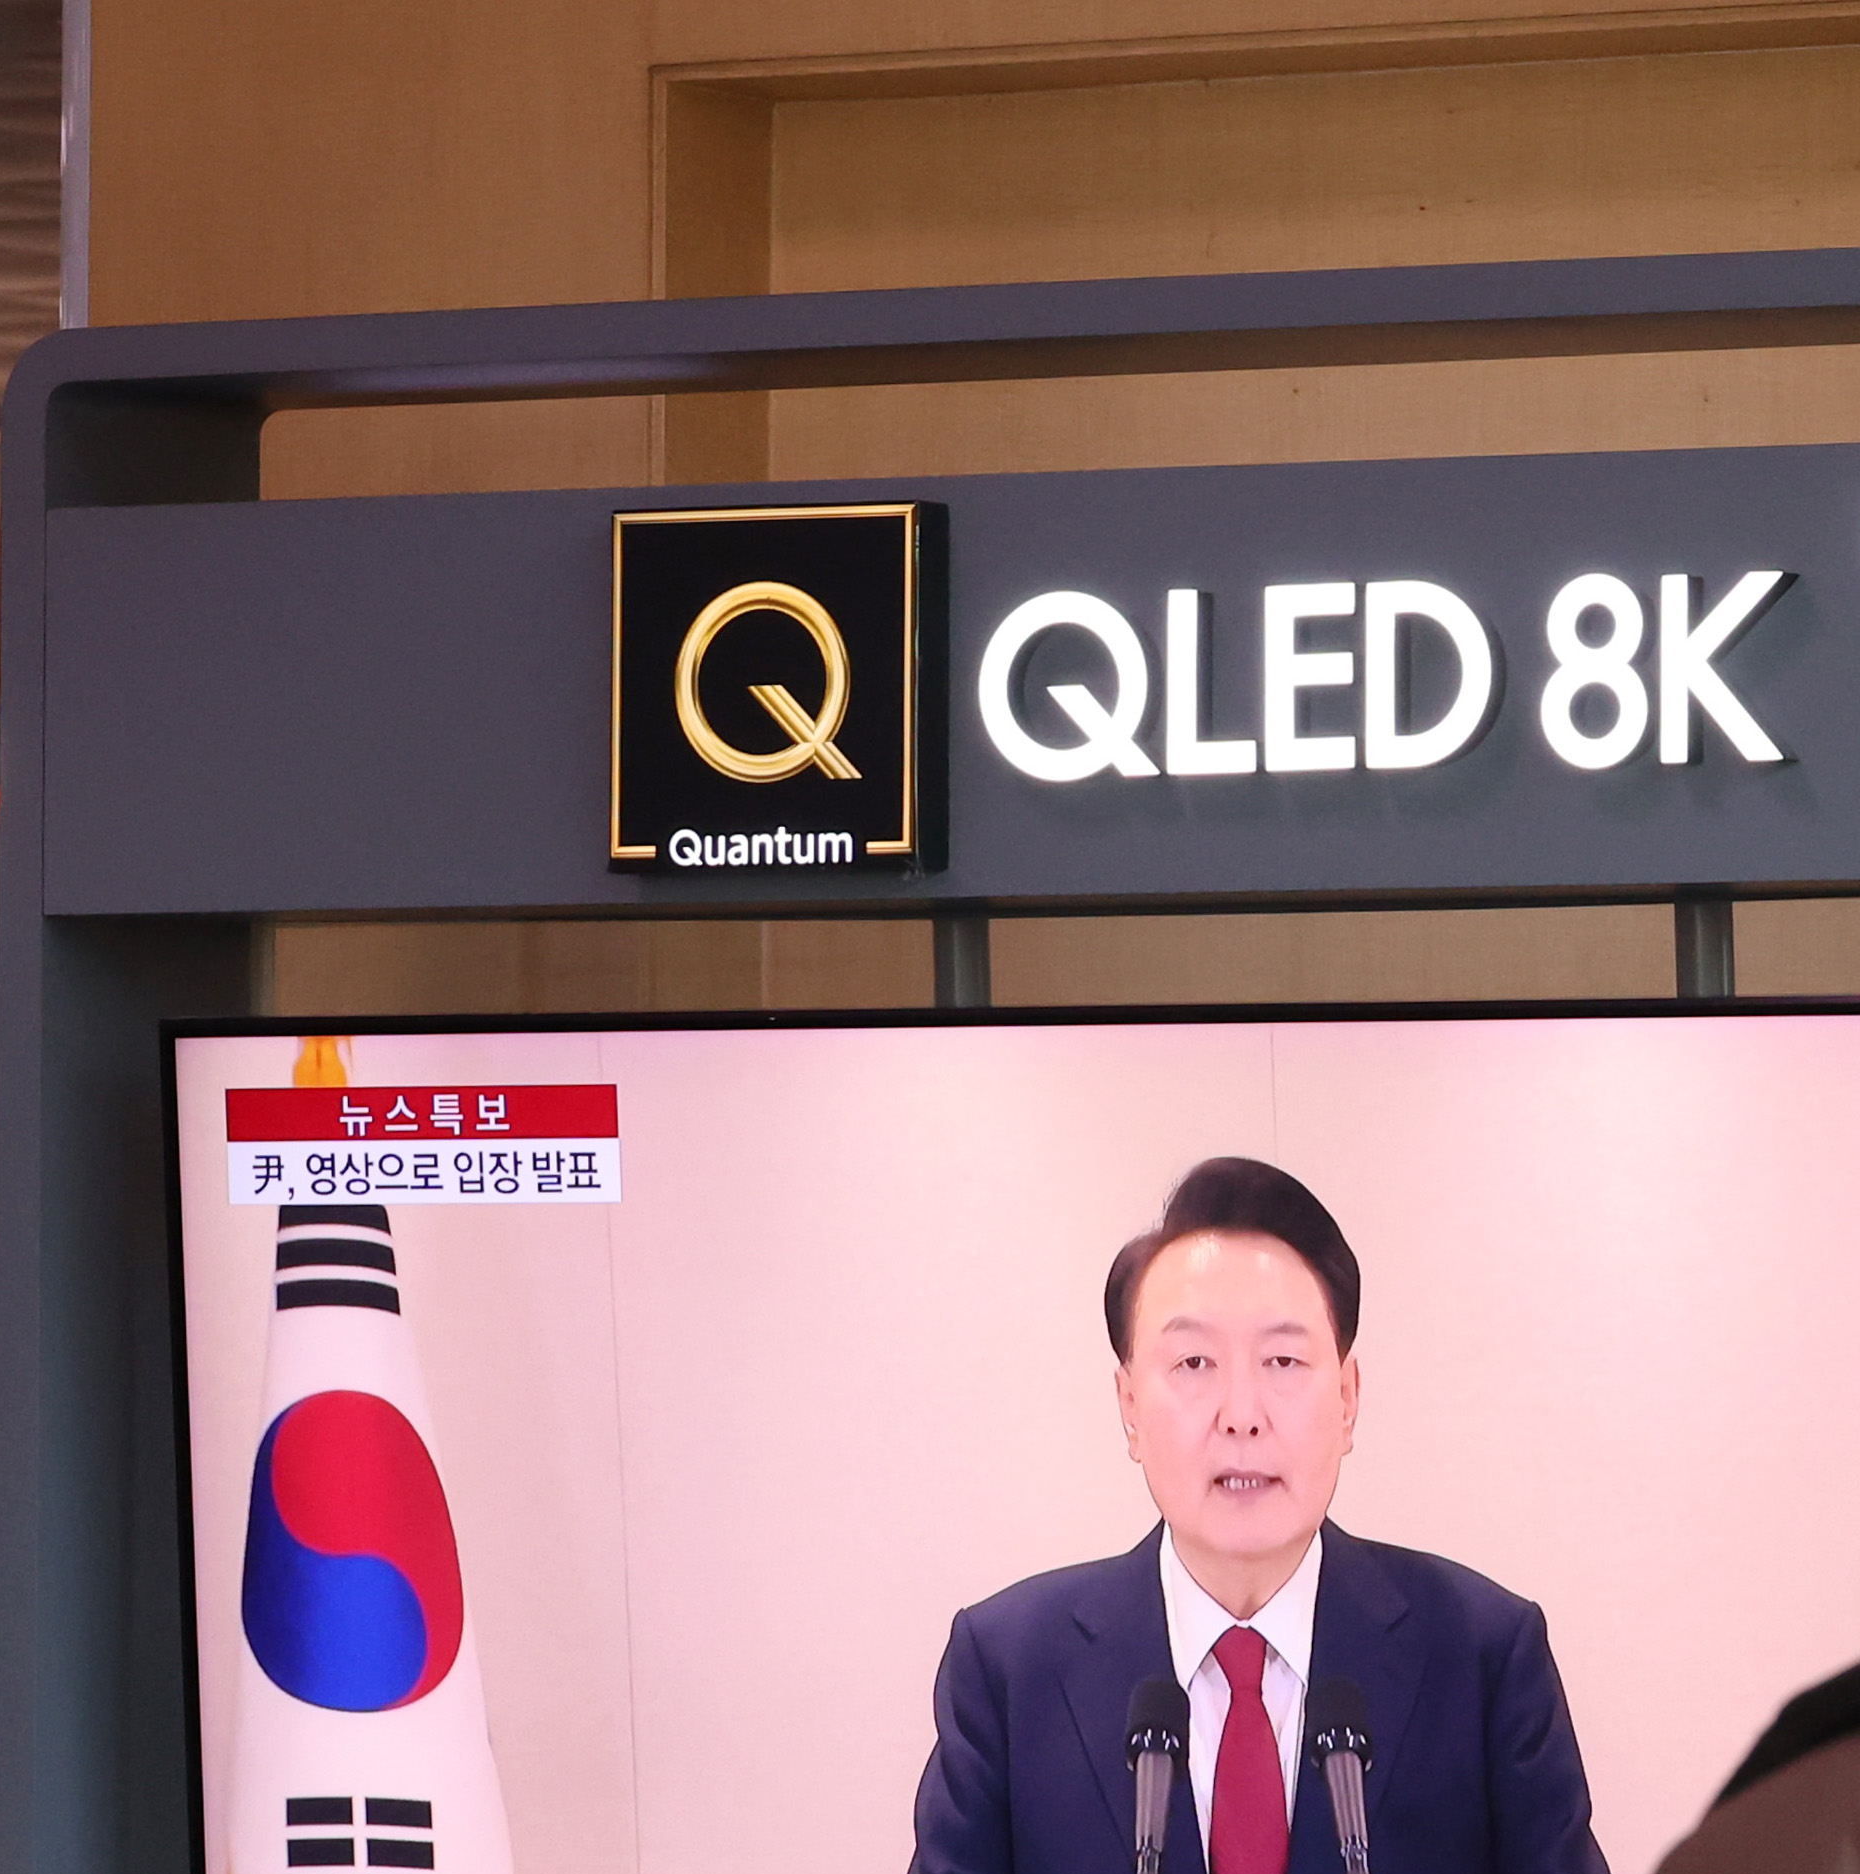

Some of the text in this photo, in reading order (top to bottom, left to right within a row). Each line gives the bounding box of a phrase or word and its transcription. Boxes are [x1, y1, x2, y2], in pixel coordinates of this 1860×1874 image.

[674, 580, 862, 783] Q
[977, 569, 1785, 783] QLED 8K
[669, 824, 854, 868] Quantum
[252, 1150, 602, 1199] 尹, 영상으로 입장 발표
